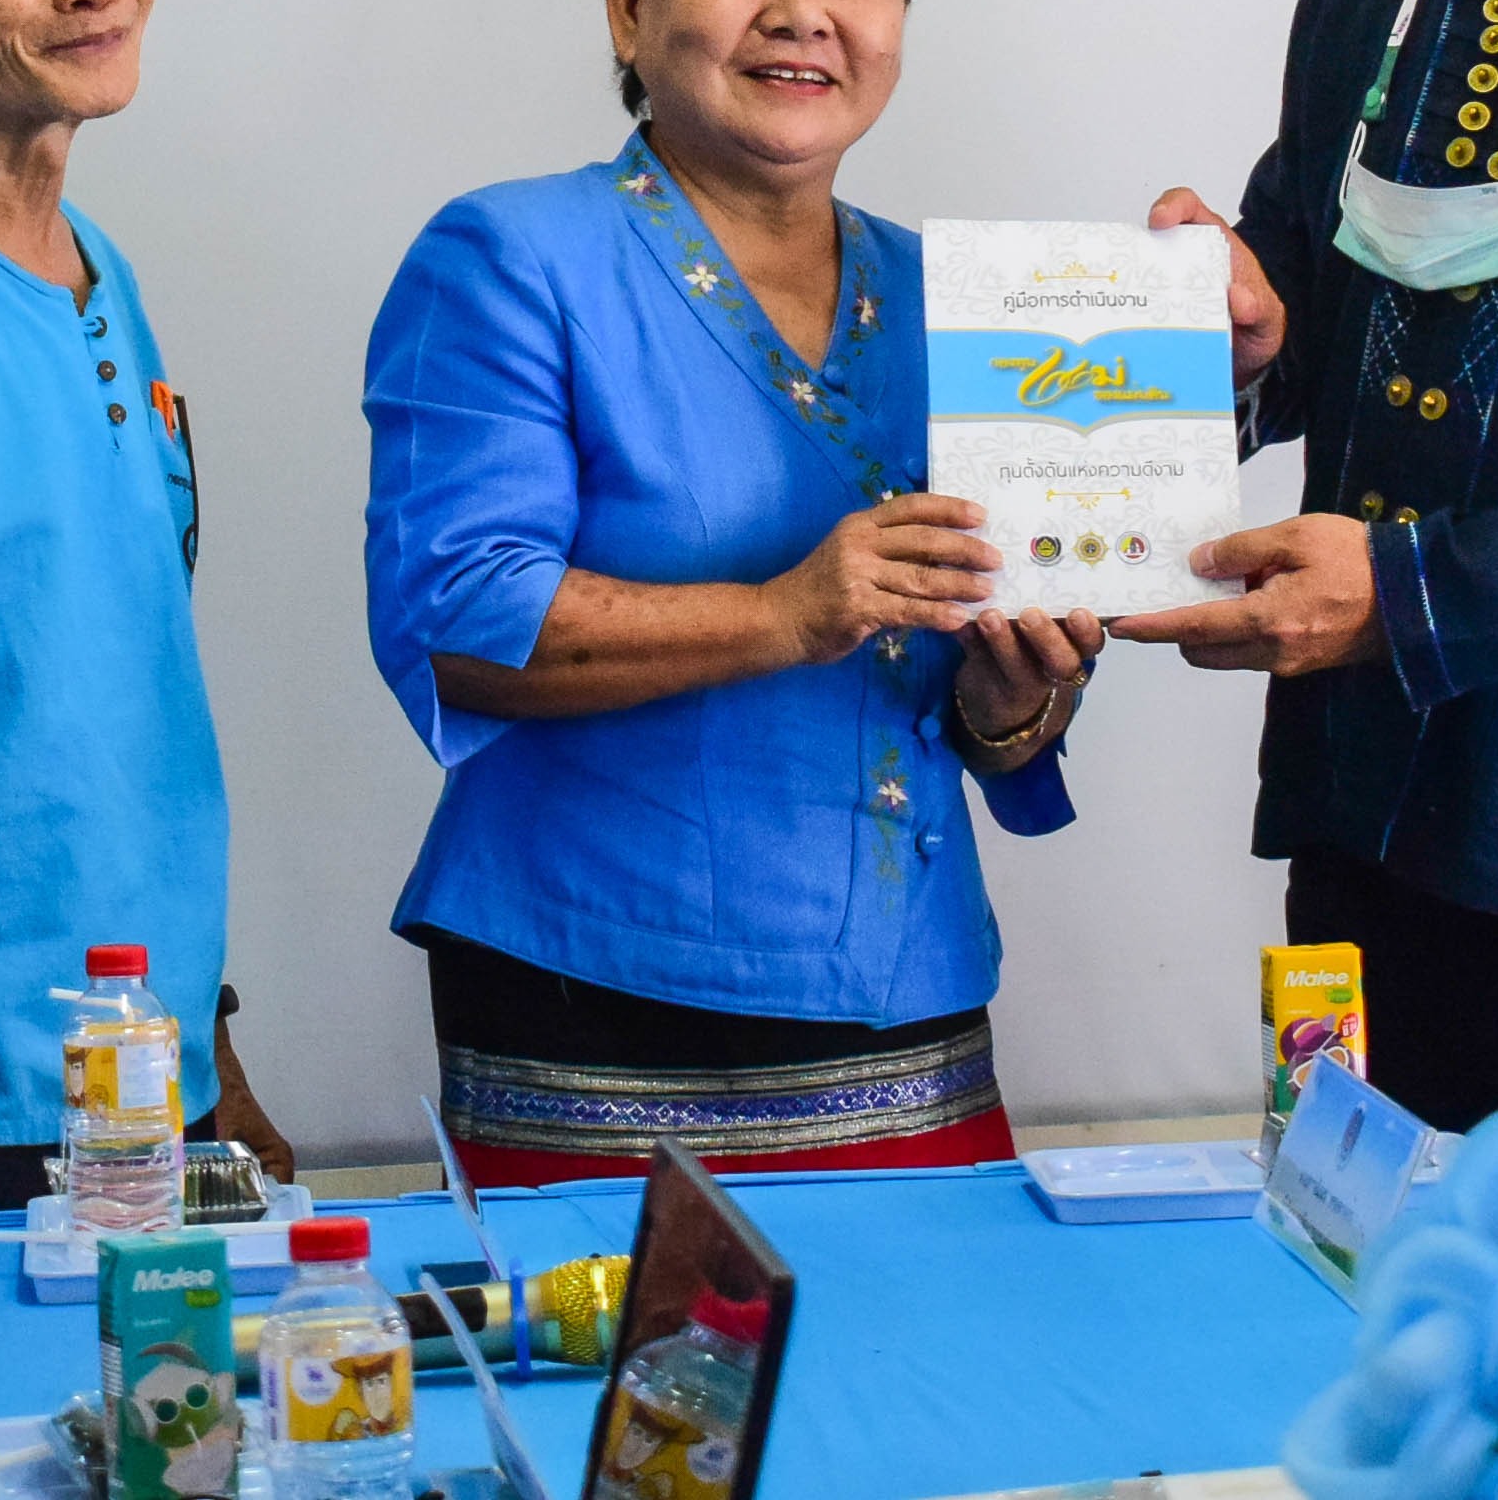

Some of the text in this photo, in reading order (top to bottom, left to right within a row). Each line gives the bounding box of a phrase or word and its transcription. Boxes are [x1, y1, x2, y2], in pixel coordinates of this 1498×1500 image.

[1003, 290, 1148, 314] คู่มือการดำเนินงาน
[999, 457, 1185, 484] ทุนตั้งต้นแห่งความดีงาม
[1284, 970, 1350, 988] Malee
[132, 1267, 216, 1292] Malee
